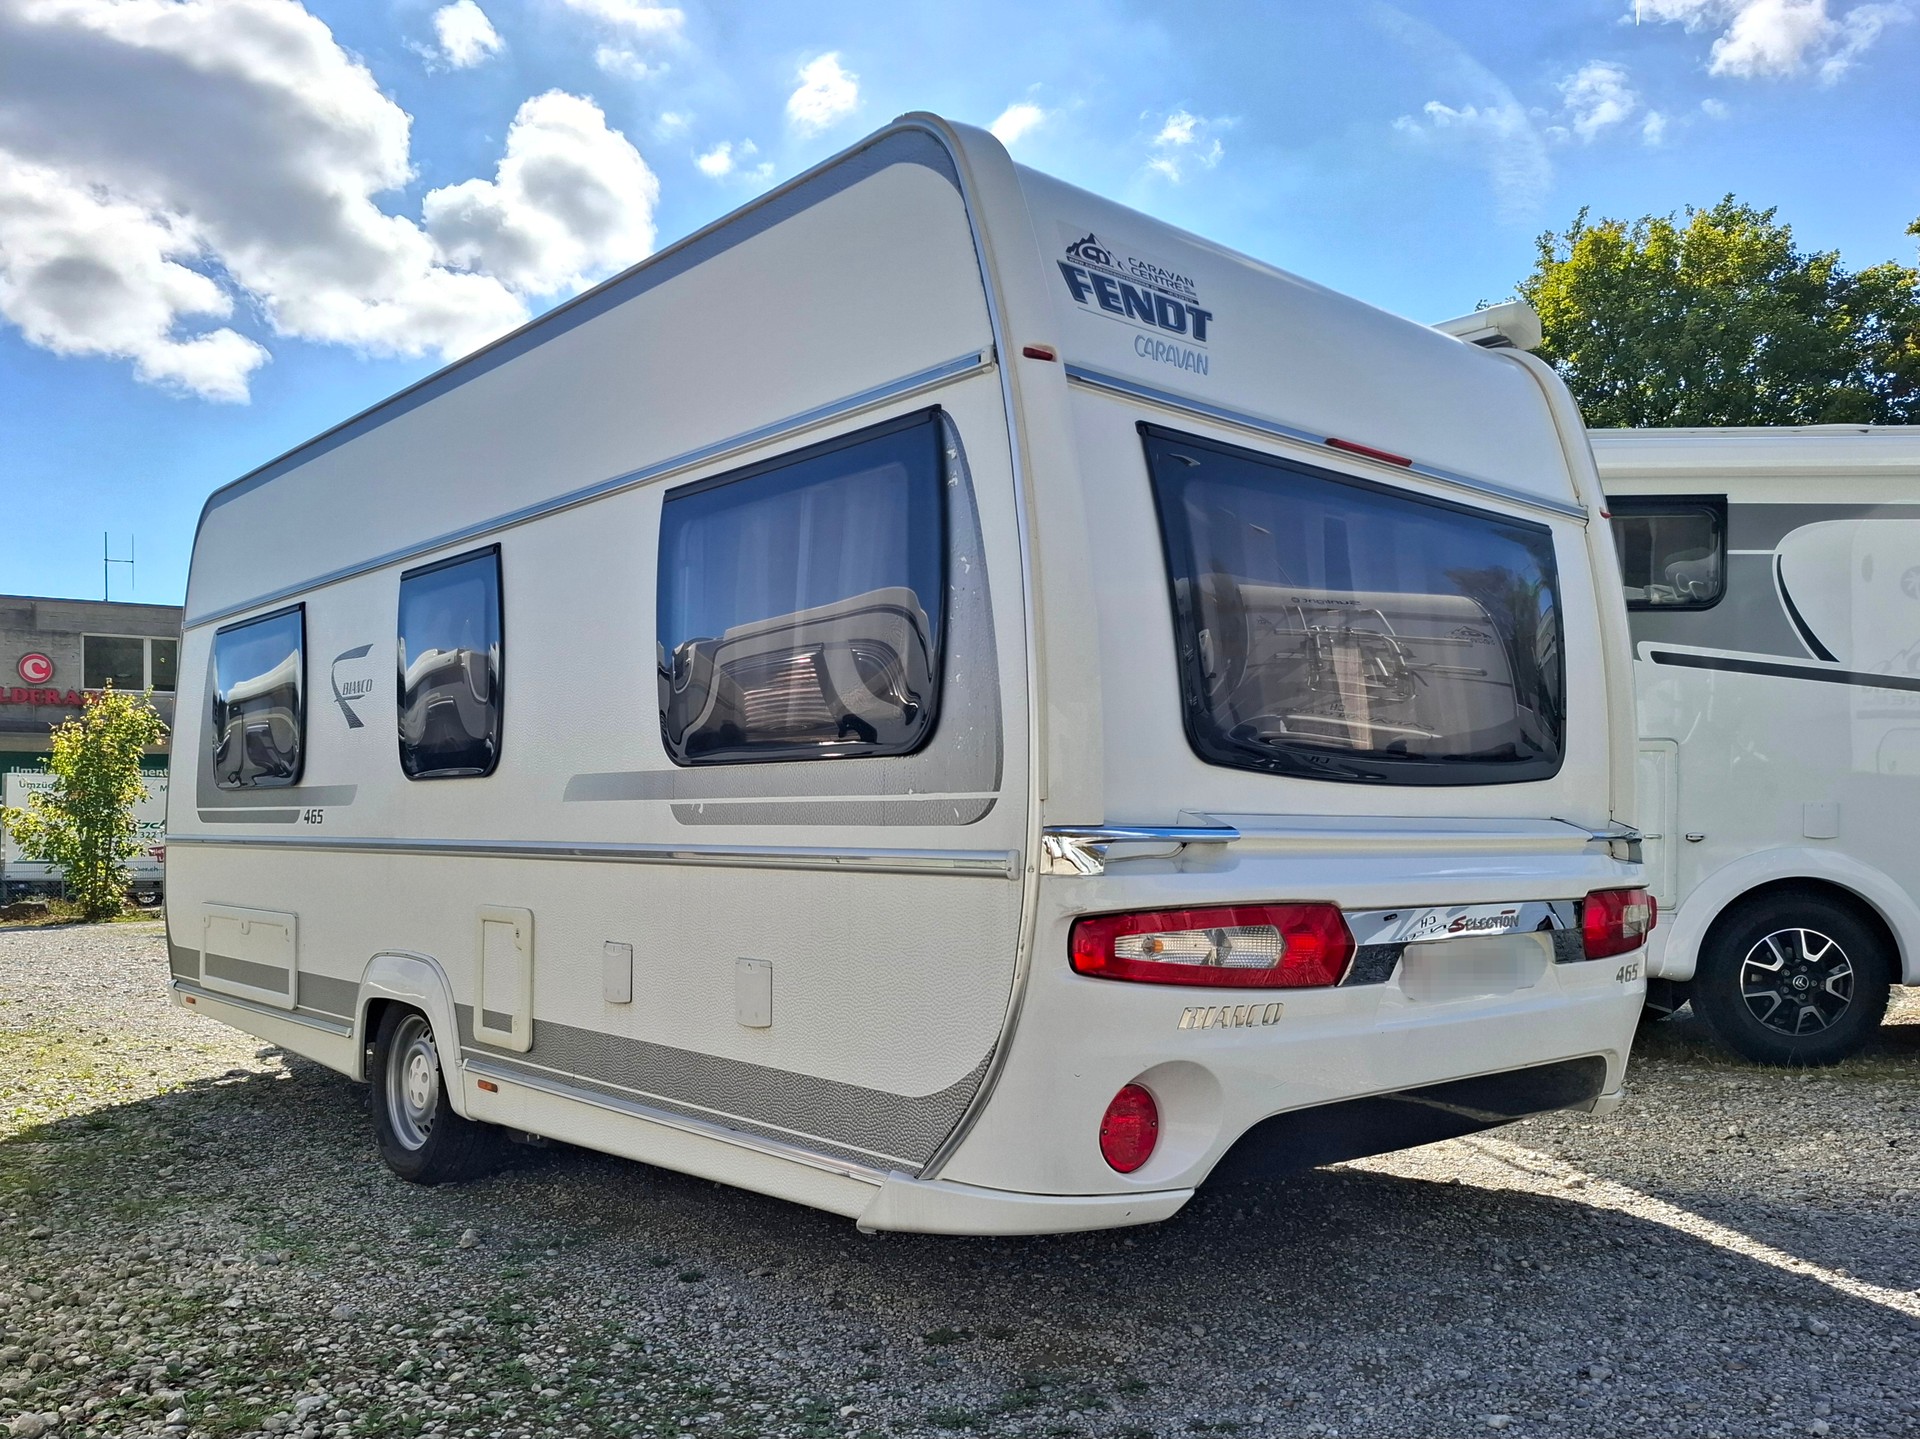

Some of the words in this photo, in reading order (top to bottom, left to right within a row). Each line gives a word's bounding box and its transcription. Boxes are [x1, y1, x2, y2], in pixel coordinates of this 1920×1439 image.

[1128, 257, 1195, 288] CARAVAN
[1131, 267, 1184, 292] CENTRE
[1057, 259, 1213, 342] FENDT
[1134, 334, 1208, 376] CARAVAN
[342, 679, 373, 695] BIANCO
[303, 809, 323, 824] 465
[1448, 914, 1520, 933] SELECTION
[1615, 962, 1639, 984] 465
